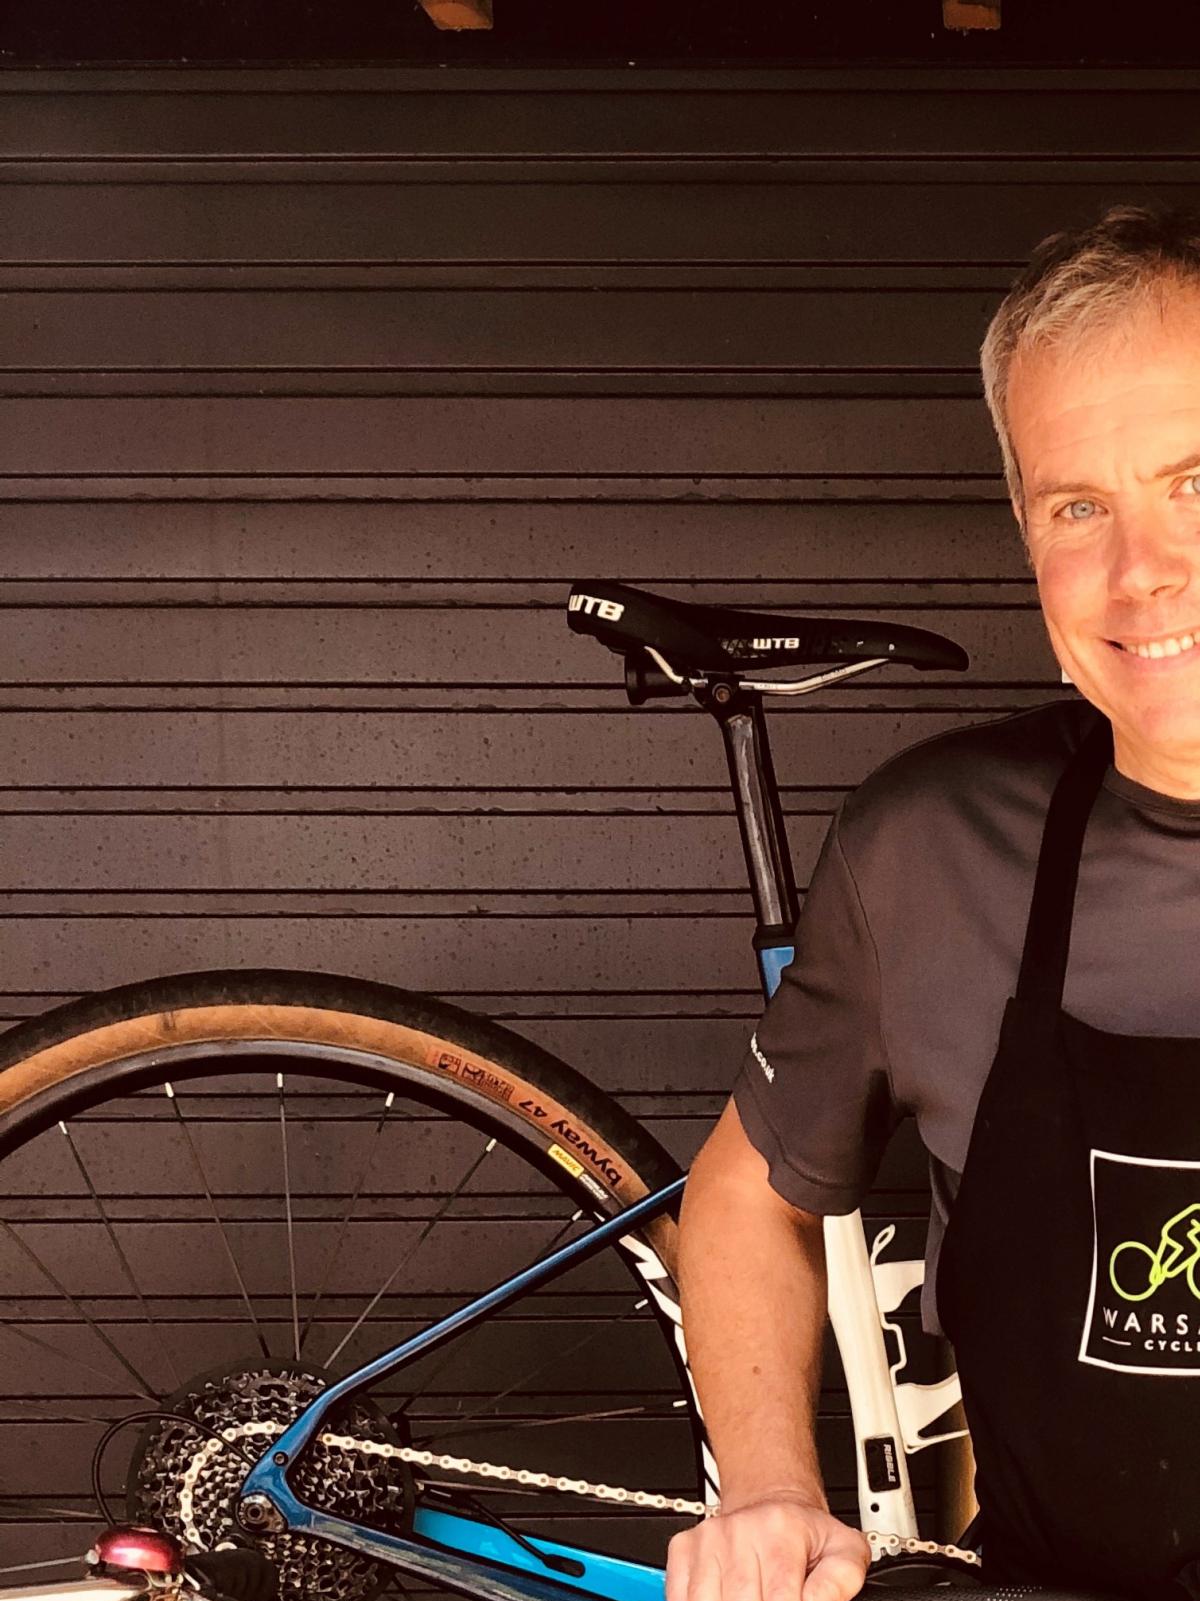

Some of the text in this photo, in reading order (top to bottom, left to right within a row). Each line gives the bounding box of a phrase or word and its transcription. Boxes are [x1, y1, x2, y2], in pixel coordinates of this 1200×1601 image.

[568, 594, 625, 622] WTB
[753, 638, 800, 649] WTB
[519, 1099, 548, 1118] 47
[550, 1119, 622, 1187] byway
[552, 1149, 581, 1172] MAVIC
[883, 1443, 897, 1483] RIBBLE
